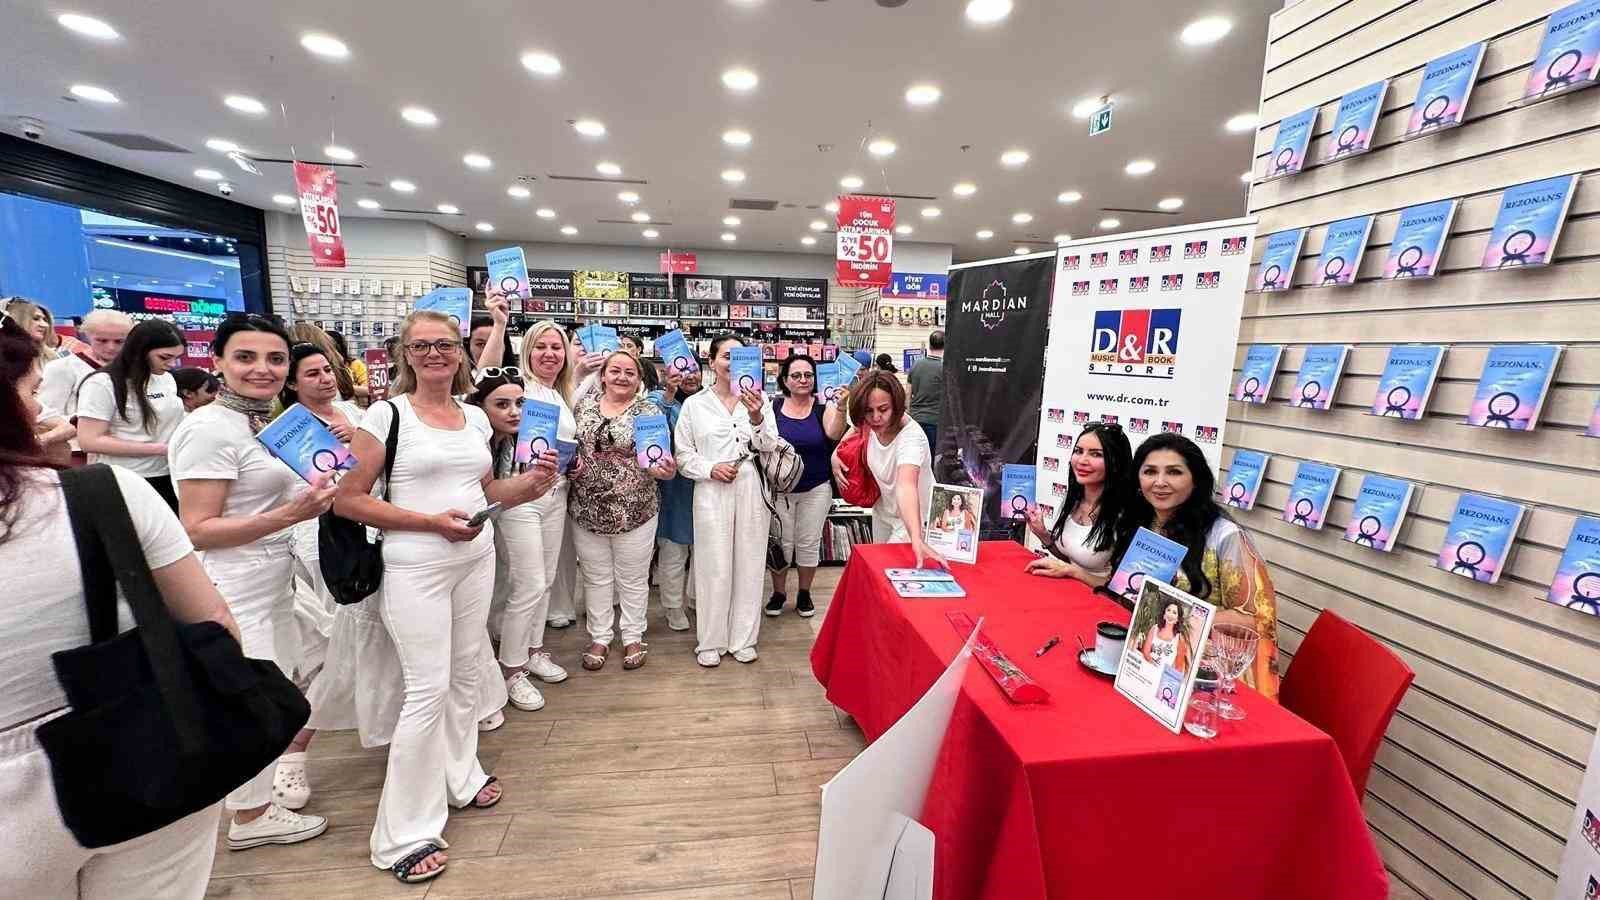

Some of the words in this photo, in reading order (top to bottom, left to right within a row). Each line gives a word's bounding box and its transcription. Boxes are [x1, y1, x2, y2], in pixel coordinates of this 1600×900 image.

[1425, 58, 1473, 80] REZONANS
[1504, 192, 1563, 209] REZONANS
[316, 205, 338, 234] 50
[852, 218, 879, 227] ÇOCUK
[1402, 214, 1446, 227] REZONANS
[840, 225, 890, 235] KİTAPLARINDA
[842, 246, 856, 257] %
[858, 236, 888, 261] 50
[851, 261, 879, 271] İNDİRİM
[904, 274, 923, 283] FİYAT
[905, 281, 921, 291] GÖR
[961, 296, 1027, 313] MARDIAN
[1093, 327, 1173, 361] D&R
[1090, 354, 1116, 362] MUSIC
[1147, 356, 1173, 365] BOOK
[1088, 363, 1175, 376] STORE
[374, 369, 387, 387] 50
[1086, 393, 1170, 407] www.dr.com.tr
[274, 416, 312, 450] REZONANS
[1298, 471, 1330, 484] REZONANS
[1362, 486, 1401, 501] REZONANS
[1458, 508, 1511, 525] REZONANS
[1135, 540, 1178, 564] REZONANS
